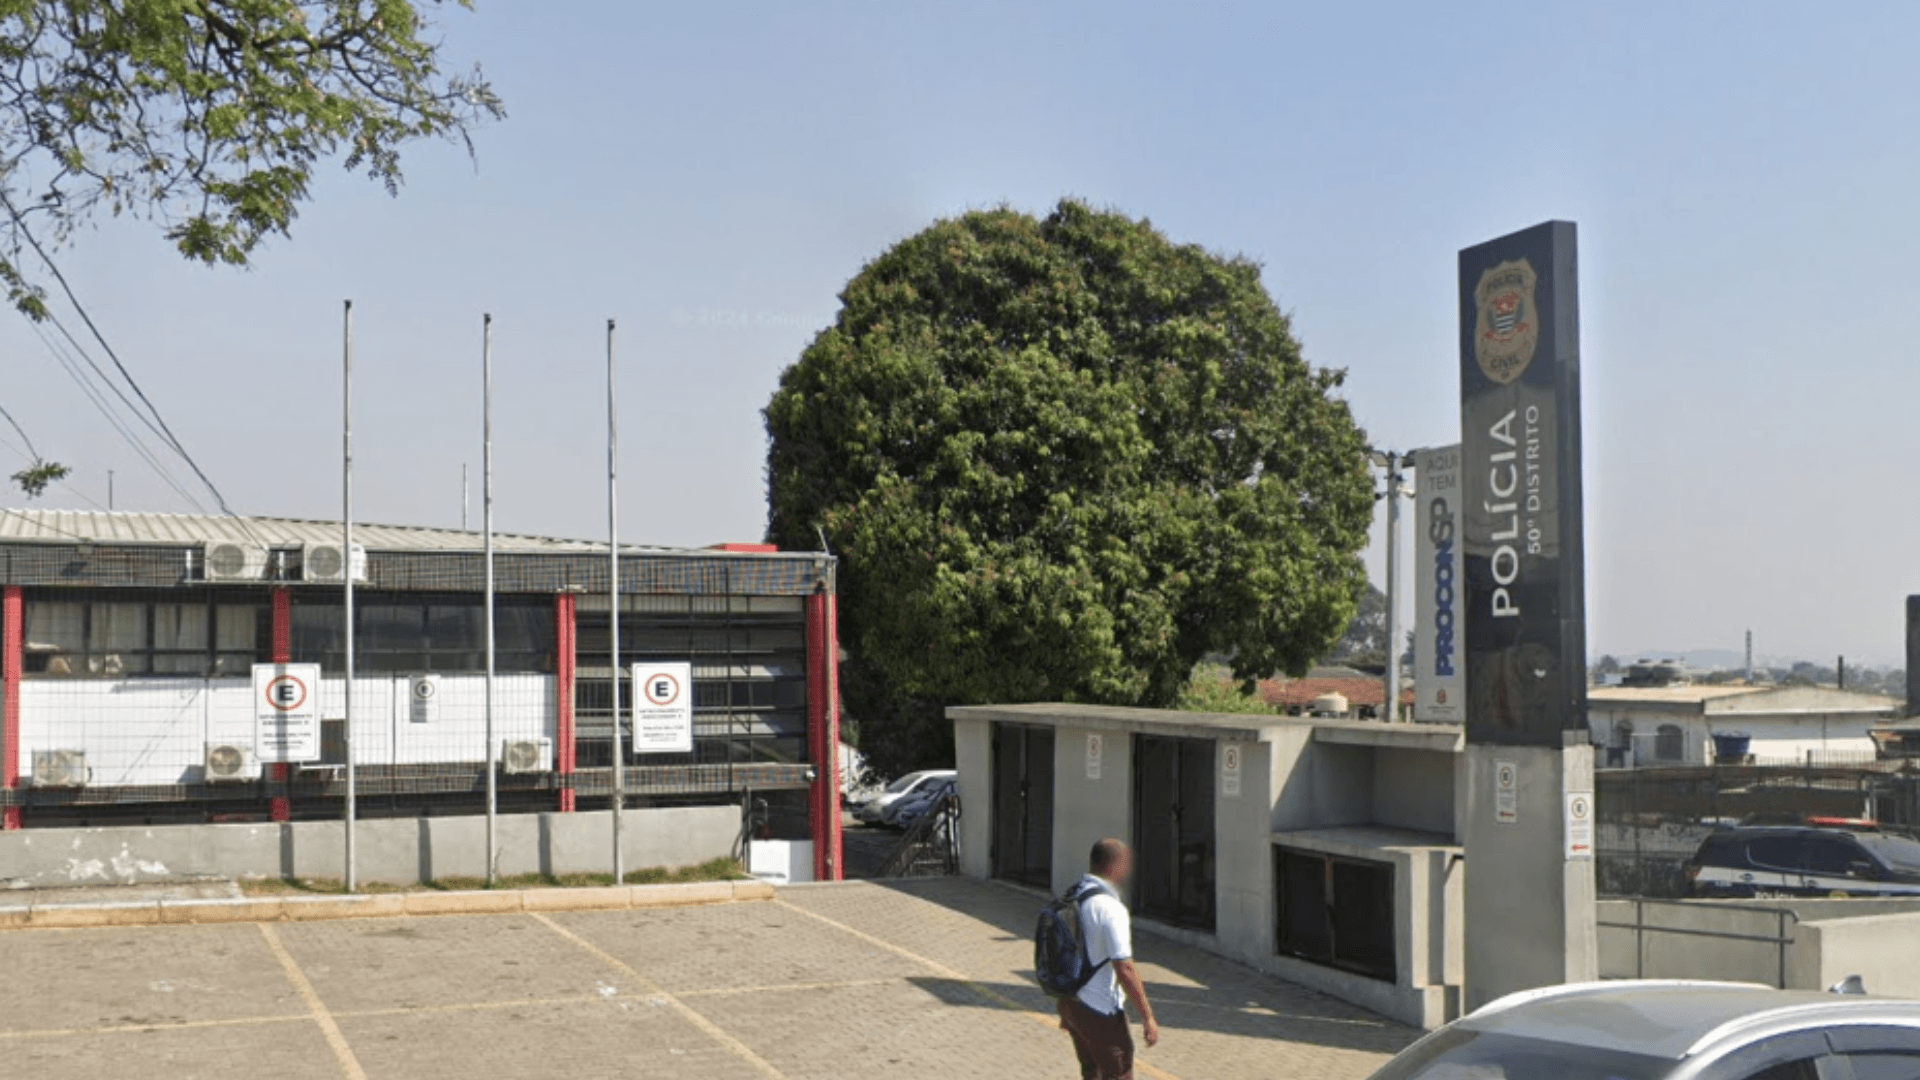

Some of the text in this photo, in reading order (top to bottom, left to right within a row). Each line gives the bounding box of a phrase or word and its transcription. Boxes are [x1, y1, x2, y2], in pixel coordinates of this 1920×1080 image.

[1426, 454, 1459, 473] AQUI
[1525, 405, 1540, 512] DISTRITO
[1428, 474, 1457, 490] TEM
[1484, 409, 1520, 618] POLÍCIA
[278, 685, 295, 701] E
[655, 681, 669, 697] E
